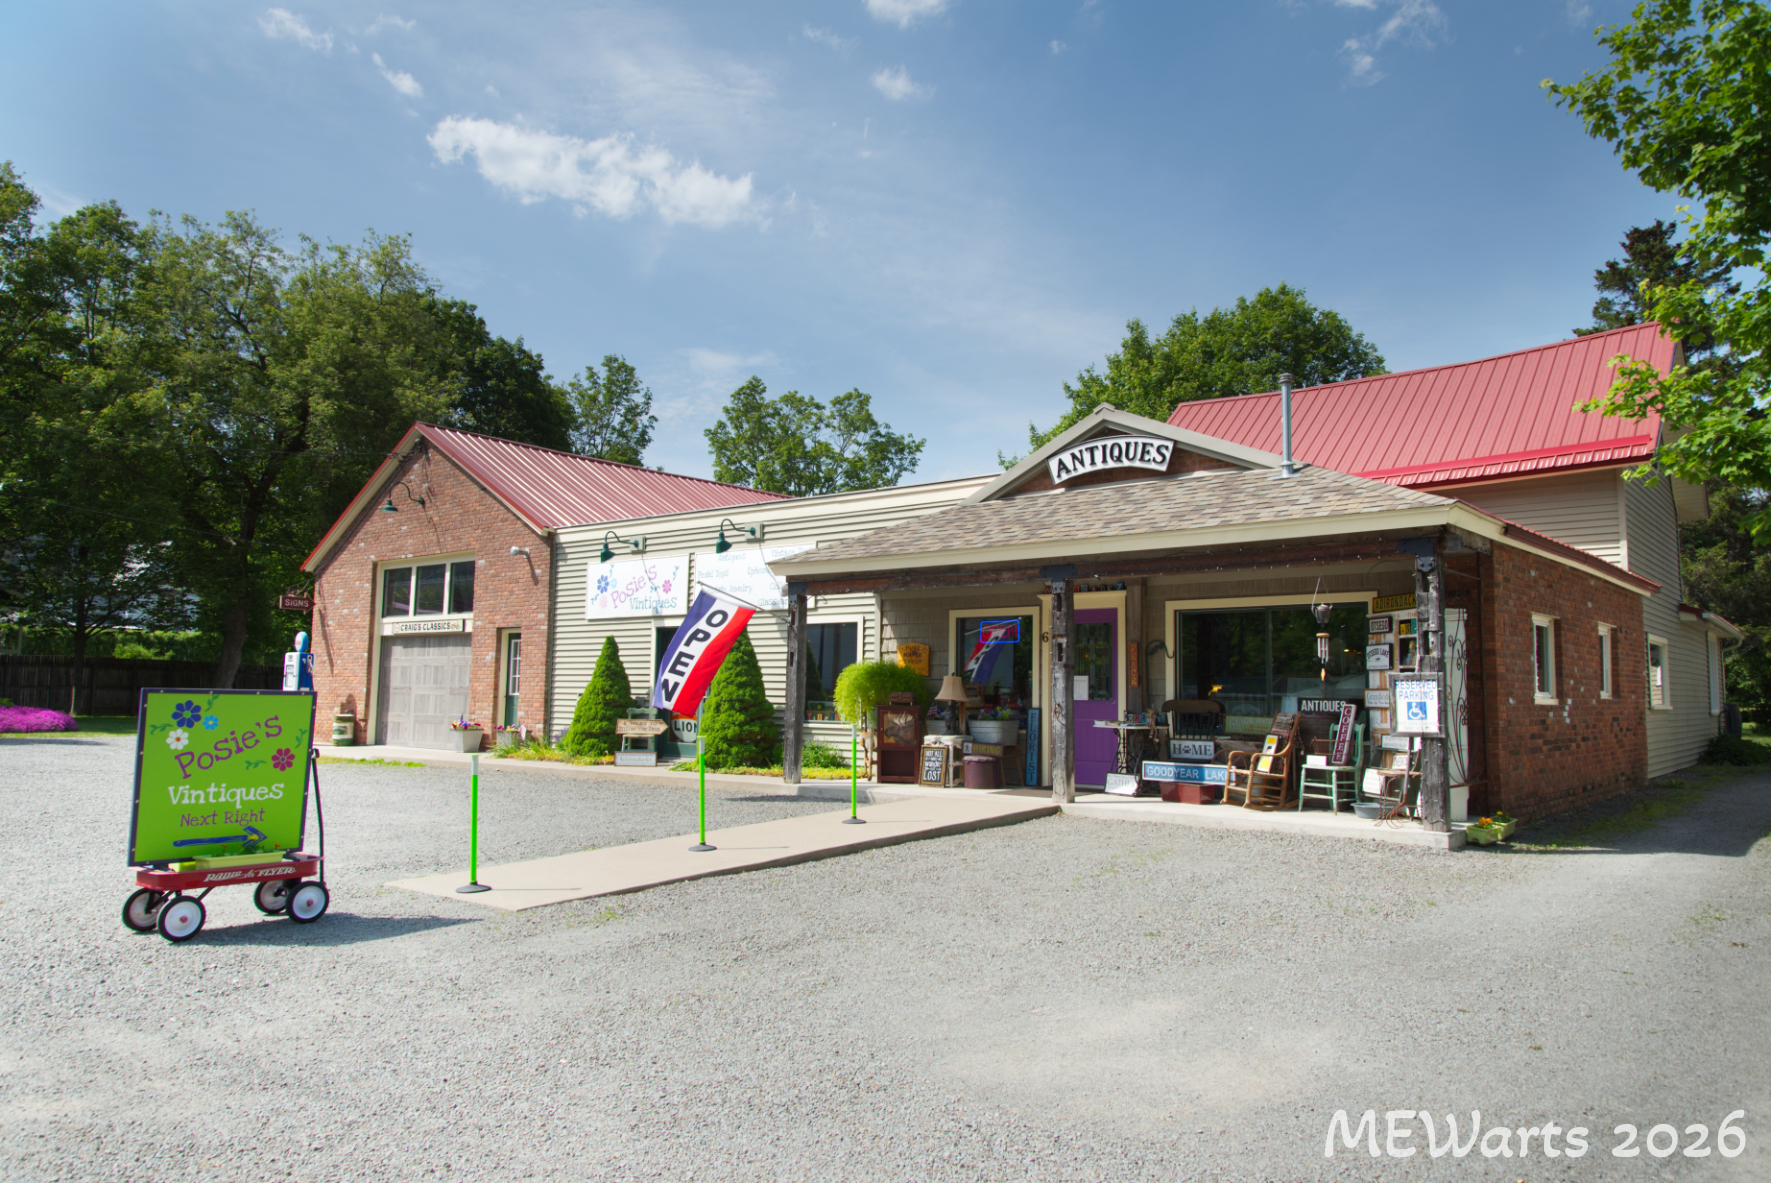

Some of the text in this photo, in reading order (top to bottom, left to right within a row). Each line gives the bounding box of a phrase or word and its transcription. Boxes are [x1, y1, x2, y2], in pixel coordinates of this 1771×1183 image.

[1056, 441, 1169, 478] ANTIQUES
[717, 552, 746, 564] Antiques
[611, 564, 658, 608] Posie's
[284, 598, 309, 608] SIGNS
[629, 596, 677, 614] Vintiques
[400, 622, 451, 632] CRAIG'S CLASSICS
[982, 624, 1018, 639] OPEN
[1370, 619, 1388, 632] OTSEGO
[1041, 631, 1050, 643] 6
[661, 609, 729, 703] OPEN
[1395, 679, 1438, 690] RESERVED
[1398, 690, 1435, 700] PARKING
[1301, 699, 1346, 713] ANTIQUES
[1336, 707, 1352, 760] COFFEE
[174, 714, 283, 780] Posie's
[925, 750, 943, 758] NOT ALL
[973, 744, 1000, 755] HIKING
[1027, 712, 1037, 782] FLORIST
[923, 770, 941, 781] LOST
[1147, 766, 1199, 779] GOODYEAR
[167, 782, 285, 809] Vintiques
[180, 807, 266, 828] Next Right
[203, 866, 296, 882] RADIO FLYER
